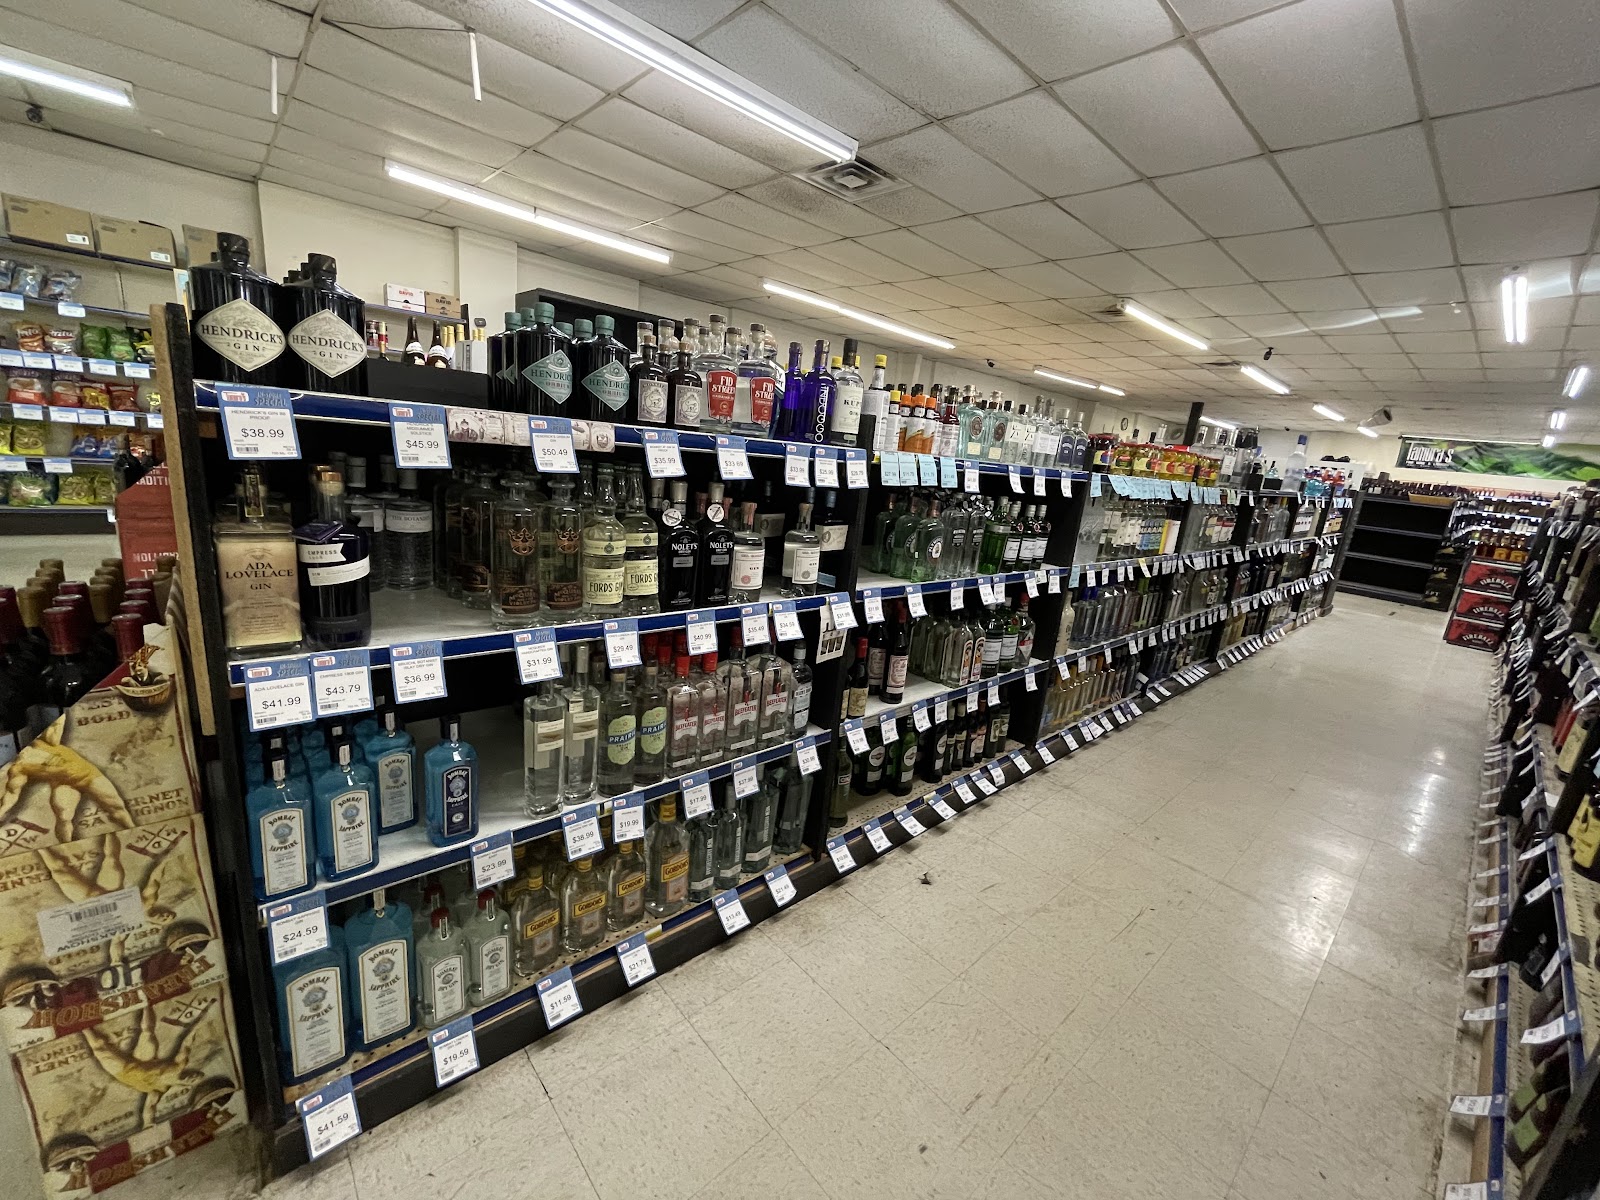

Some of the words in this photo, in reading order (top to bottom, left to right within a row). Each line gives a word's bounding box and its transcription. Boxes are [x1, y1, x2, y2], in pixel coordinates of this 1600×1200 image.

[436, 298, 452, 306] DAVID
[202, 324, 283, 345] HENDRICK'S
[234, 342, 260, 352] GIN
[292, 334, 364, 353] HENDRICK'S
[319, 350, 343, 360] GIN
[531, 369, 572, 381] HENDRIC
[241, 428, 284, 438] $38.99
[406, 440, 439, 449] $45.99
[542, 448, 568, 456] $50.49
[1406, 440, 1454, 463] Tamura's
[672, 542, 698, 551] NOLET'S
[710, 541, 733, 549] NOLET'S
[246, 562, 274, 570] ADA
[226, 569, 294, 580] LOVELACE
[630, 574, 653, 584] FORDS
[590, 582, 613, 592] FORDS
[1480, 576, 1513, 589] FIREBALL
[1472, 606, 1505, 618] FIREBALL
[748, 625, 765, 634] $35.49
[693, 633, 712, 642] $40.99
[1462, 634, 1494, 646] FIREBALL
[613, 645, 634, 653] $29.49
[527, 657, 552, 668] $31.99
[404, 674, 435, 684] $36.99
[326, 684, 361, 696] $43.79
[262, 696, 301, 710] $41.99
[766, 697, 787, 707] BEEFEATER
[734, 706, 757, 716] BEEFEATER
[77, 710, 131, 726] BOLD
[705, 716, 724, 726] BEEFEATER
[676, 721, 697, 731] BEEFEATER
[385, 758, 406, 768] BOMBAY
[447, 769, 468, 780] BOMBAY
[338, 797, 363, 808] BOMBAY
[447, 792, 469, 803] SAPPHIRE
[268, 814, 296, 827] BOMBAY
[338, 820, 366, 832] SAPPHIRE
[620, 819, 639, 829] $19.99
[269, 840, 299, 852] SAPPHIRE
[482, 859, 507, 873] $23.99
[665, 861, 689, 875] GORDON'S
[622, 878, 644, 891] GORDON'S
[578, 898, 603, 912] GORDON'S
[530, 915, 556, 932] GORDON'S
[283, 926, 318, 943] $24.59
[368, 948, 398, 963] BOMBAY
[485, 947, 504, 957] BOMBAY
[629, 958, 647, 971] $21.79
[437, 967, 458, 978] BOMBAY
[299, 976, 330, 993] BOMBAY
[368, 975, 402, 992] SAPPHIRE
[550, 994, 572, 1010] $11.59
[300, 1005, 334, 1022] SAPPHIRE
[443, 1048, 469, 1066] $19.59
[317, 1113, 349, 1135] $41.59
